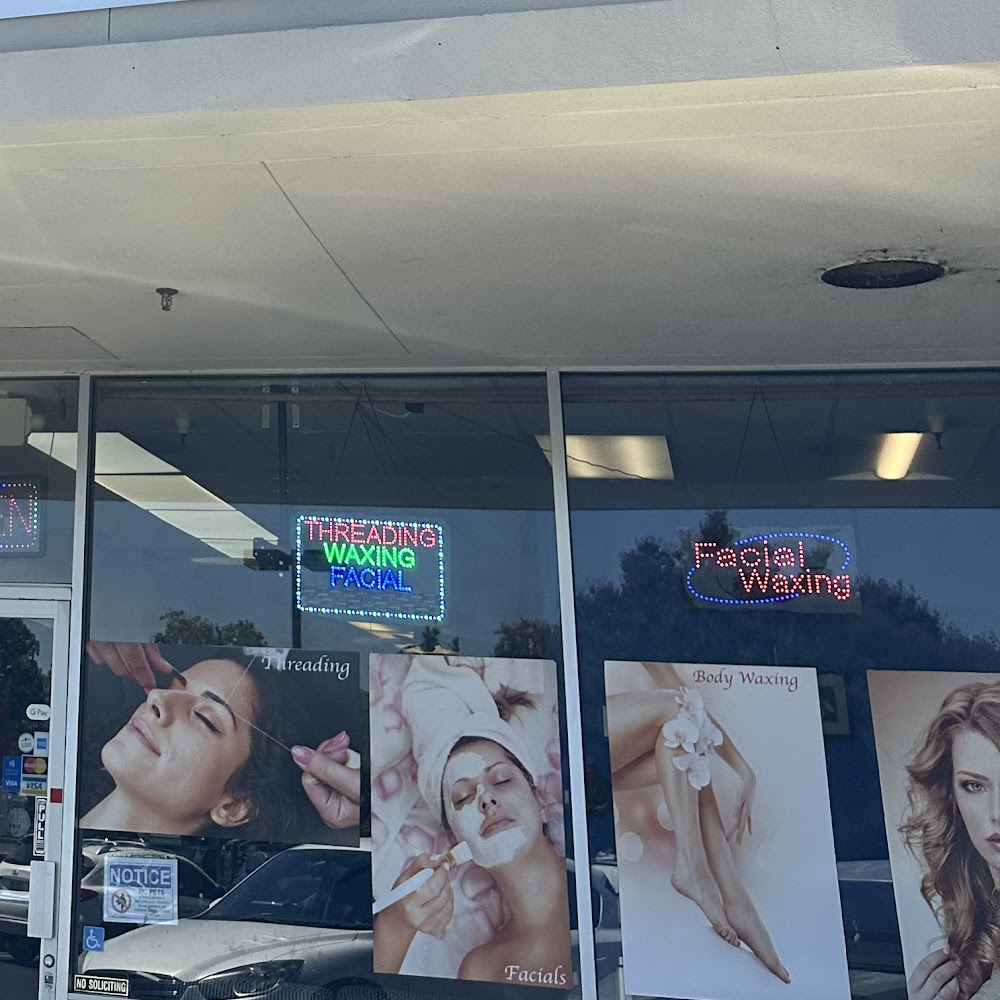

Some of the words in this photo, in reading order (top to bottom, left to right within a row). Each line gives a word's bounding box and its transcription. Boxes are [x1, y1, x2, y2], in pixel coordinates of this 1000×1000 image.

[304, 519, 437, 548] THREADING
[322, 541, 417, 569] WAXING
[694, 539, 805, 569] Facial
[329, 565, 413, 593] FACIAL
[738, 567, 851, 600] Waxing
[692, 667, 733, 690] Body
[738, 671, 798, 692] Waxing
[37, 708, 48, 717] Pay
[5, 779, 18, 787] VISA
[26, 781, 43, 790] VISA
[37, 803, 46, 840] PULL
[110, 867, 171, 886] NOTICE
[76, 978, 86, 989] NO
[88, 978, 126, 992] SOLICITING
[504, 965, 566, 985] Facials
